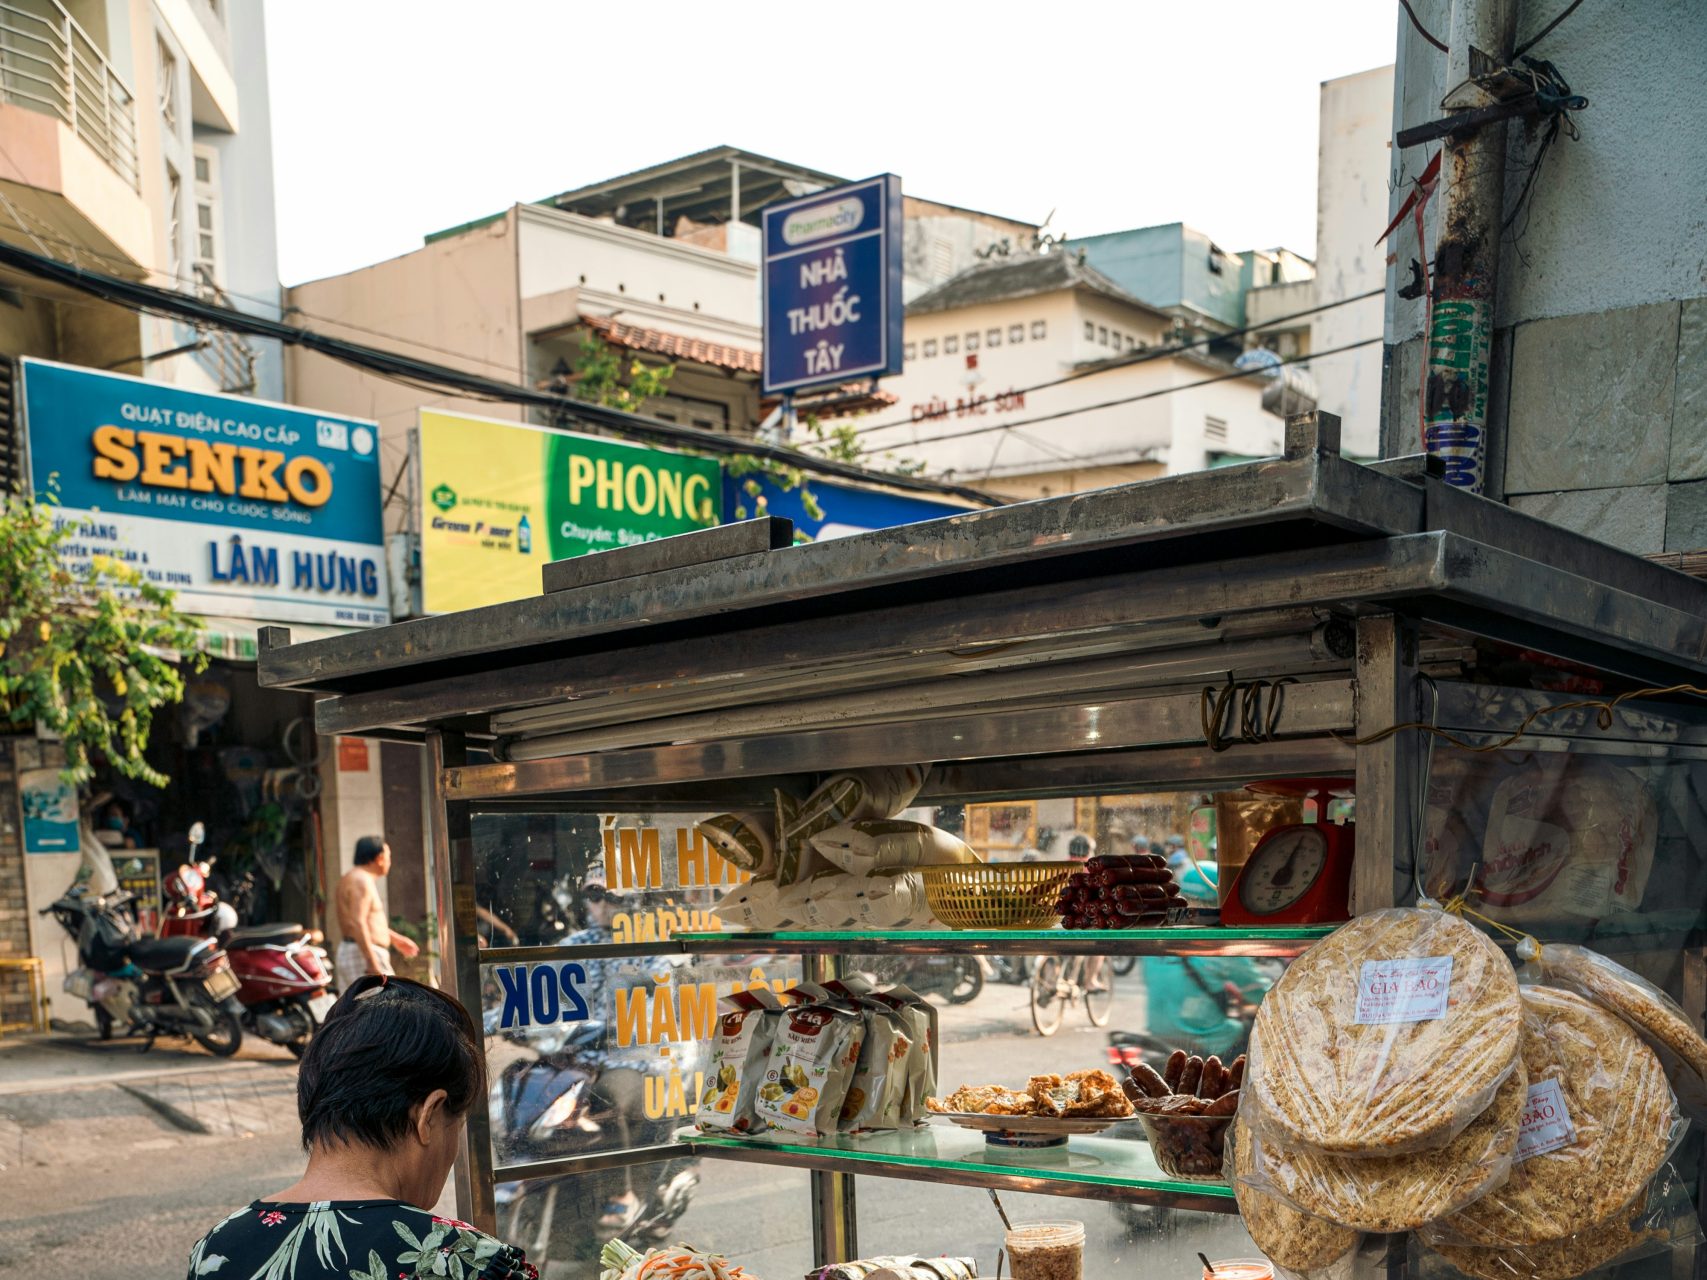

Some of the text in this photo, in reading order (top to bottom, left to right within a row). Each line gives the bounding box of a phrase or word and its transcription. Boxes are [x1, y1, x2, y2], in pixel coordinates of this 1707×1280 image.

[800, 248, 848, 289] NHÀ
[787, 287, 861, 335] THUỐC
[804, 340, 845, 375] TÂY
[120, 403, 300, 446] QUẠT ĐIỆN CAO CẤP
[92, 424, 333, 507] SENKO
[190, 497, 225, 513] CHO
[568, 453, 714, 523] PHONG
[208, 534, 379, 597] LÂM HƯNG
[1370, 981, 1400, 995] GIA
